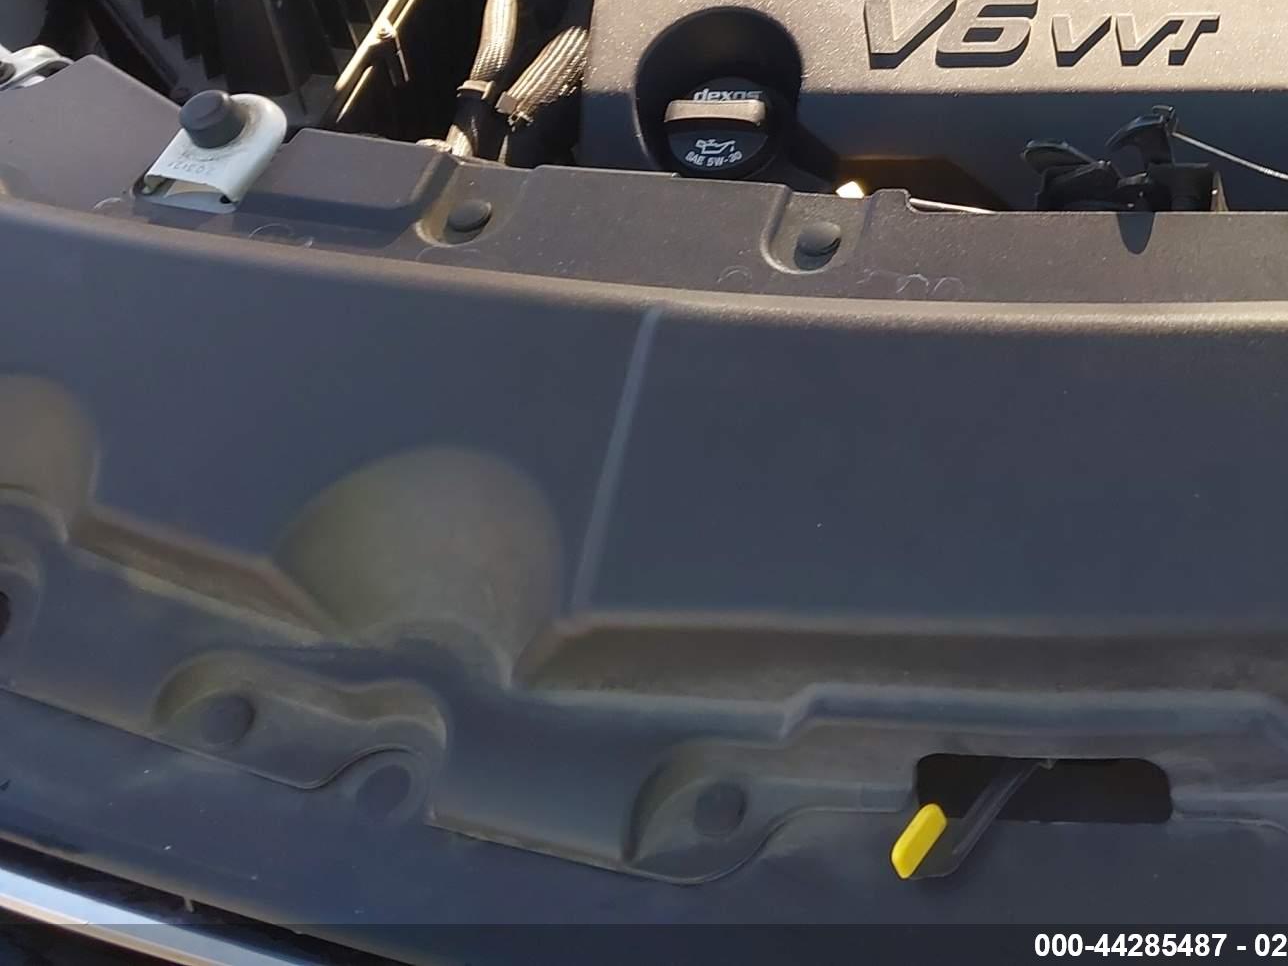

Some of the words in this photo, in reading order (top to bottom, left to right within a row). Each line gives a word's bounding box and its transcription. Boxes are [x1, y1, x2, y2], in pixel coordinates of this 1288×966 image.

[1051, 13, 1221, 67] VVT
[693, 88, 763, 101] dexos
[685, 151, 704, 166] SAE
[706, 151, 743, 167] 5W-30
